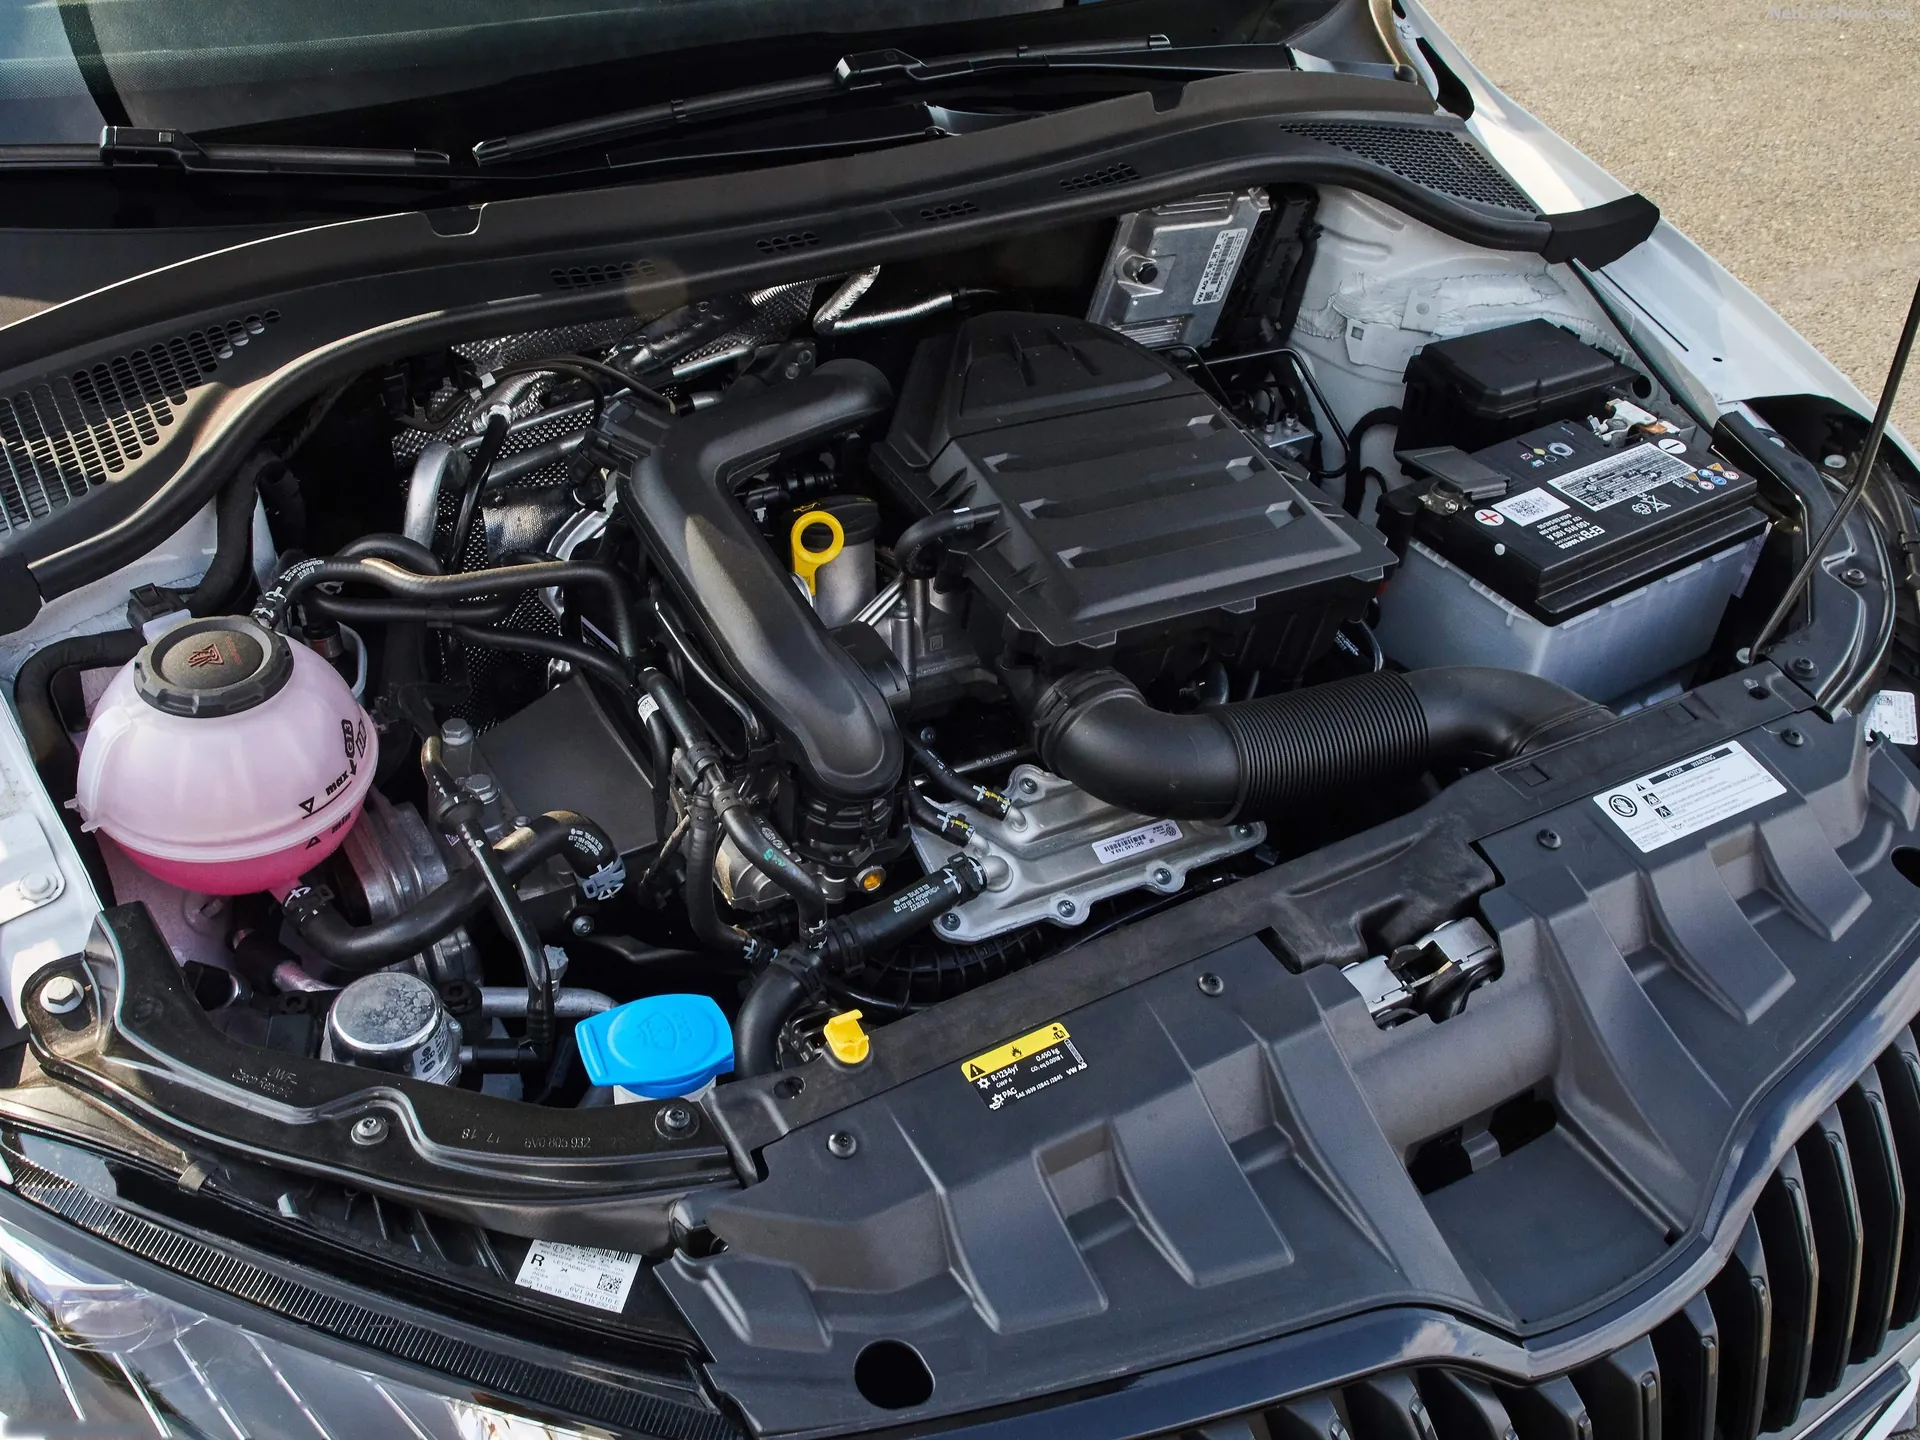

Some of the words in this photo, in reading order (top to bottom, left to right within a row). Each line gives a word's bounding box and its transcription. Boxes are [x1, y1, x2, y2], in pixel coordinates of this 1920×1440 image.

[1580, 525, 1605, 538] EFB
[1691, 754, 1716, 767] WARNING
[326, 770, 349, 796] max
[331, 812, 351, 834] min
[1036, 1051, 1051, 1061] 0.450
[991, 1064, 1018, 1082] R-1234yf
[1066, 1067, 1077, 1075] VW
[1078, 1062, 1087, 1071] AG
[1002, 1087, 1017, 1098] PAG
[571, 1137, 590, 1148] 932
[531, 1253, 545, 1266] R
